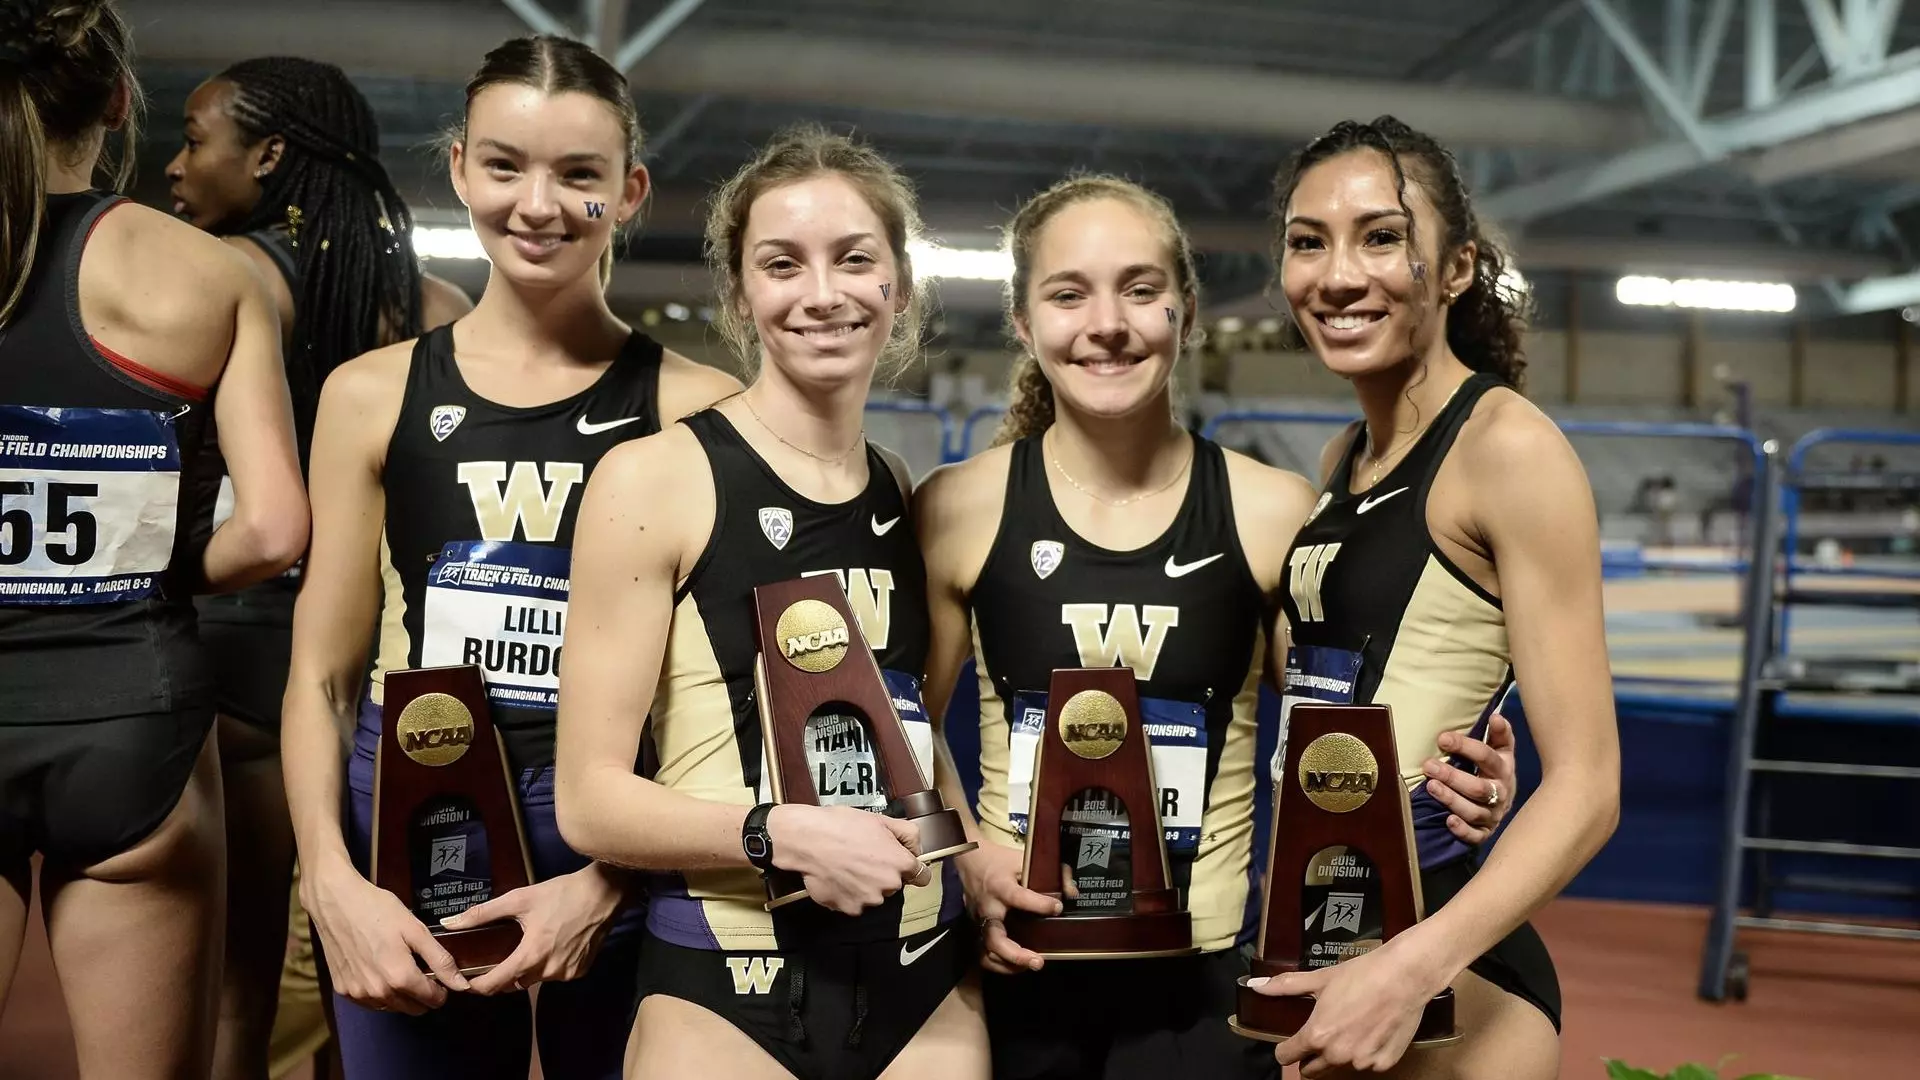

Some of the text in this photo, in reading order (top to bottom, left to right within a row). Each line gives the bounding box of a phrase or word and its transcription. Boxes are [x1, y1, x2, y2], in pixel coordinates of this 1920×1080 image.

[583, 201, 606, 219] W
[6, 441, 48, 457] FIELD
[50, 443, 168, 460] CHAMPIONSHIPS
[457, 460, 584, 542] W
[0, 481, 99, 566] 55
[70, 583, 84, 595] AL
[94, 579, 131, 594] MARCH
[132, 578, 152, 590] 8-9
[464, 568, 501, 583] TRACK
[501, 574, 511, 584] &
[511, 573, 541, 588] FIELD
[1289, 542, 1342, 622] W
[503, 605, 562, 636] LILLI
[786, 627, 849, 659] NCAA
[1061, 602, 1180, 682] W
[490, 687, 546, 702] BIRMINGHAM,
[817, 714, 839, 728] 2019
[406, 724, 471, 752] NCAA
[1065, 723, 1124, 742] NCAA
[1306, 770, 1373, 793] NCAA
[1083, 800, 1107, 809] 2019
[1072, 810, 1112, 820] DIVISION
[1330, 856, 1356, 866] 2019
[1317, 865, 1363, 878] DIVISION
[433, 885, 457, 897] TRACK
[464, 881, 483, 892] FIELD
[1078, 880, 1100, 888] TRACK
[1105, 880, 1124, 888] FIELD
[1324, 945, 1348, 955] TRACK
[726, 957, 784, 994] W
